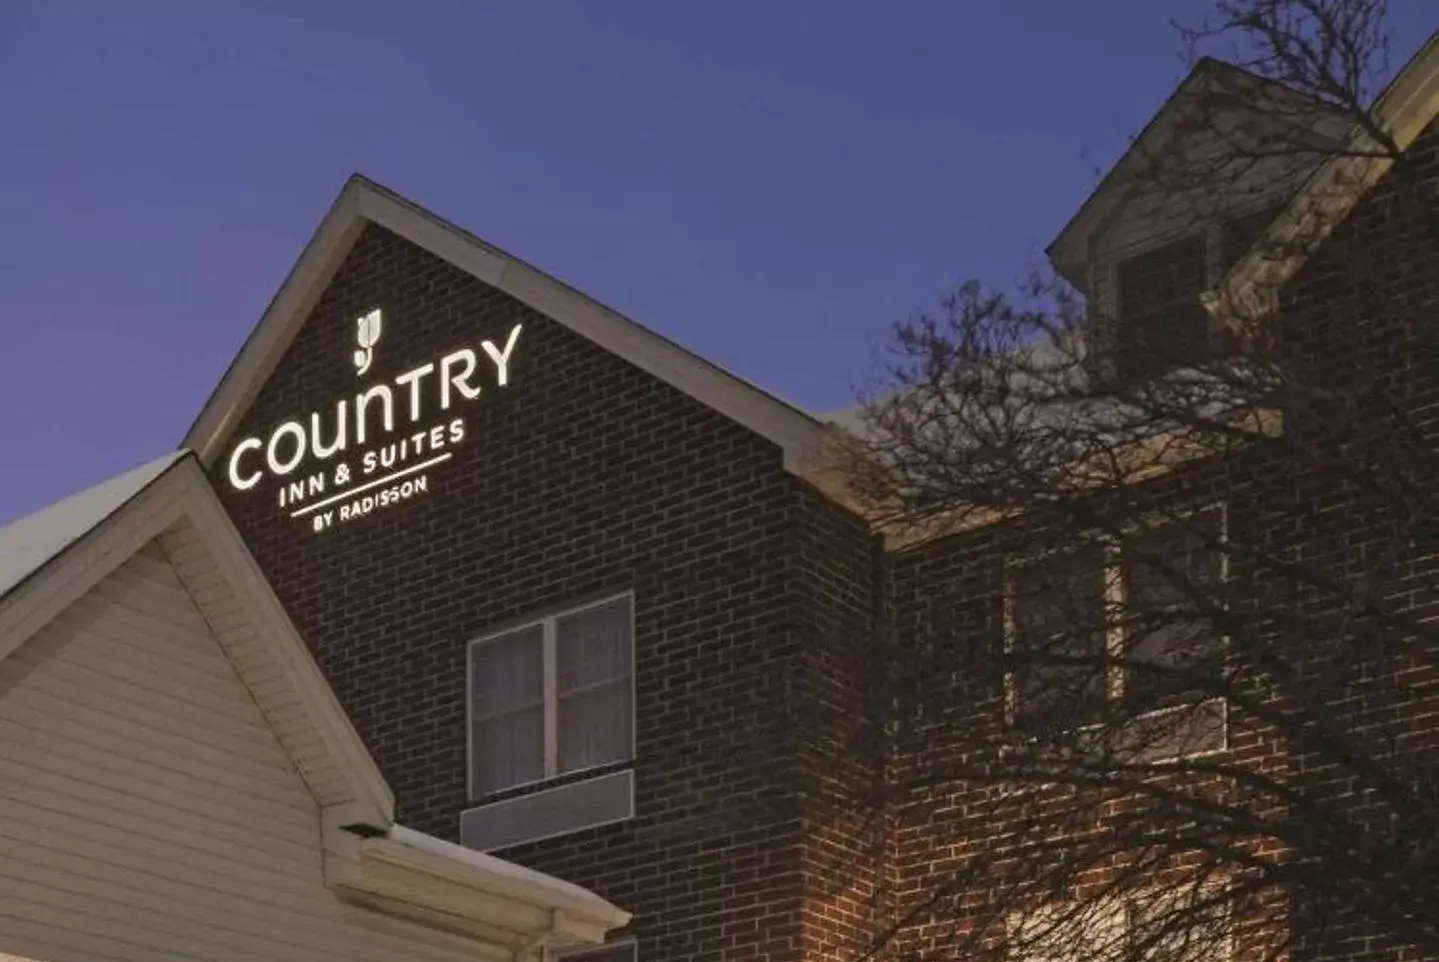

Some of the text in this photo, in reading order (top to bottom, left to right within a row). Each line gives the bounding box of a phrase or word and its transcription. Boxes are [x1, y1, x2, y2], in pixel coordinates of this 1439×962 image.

[278, 419, 466, 508] INN & SUITES
[313, 475, 428, 532] BY RADISSON
